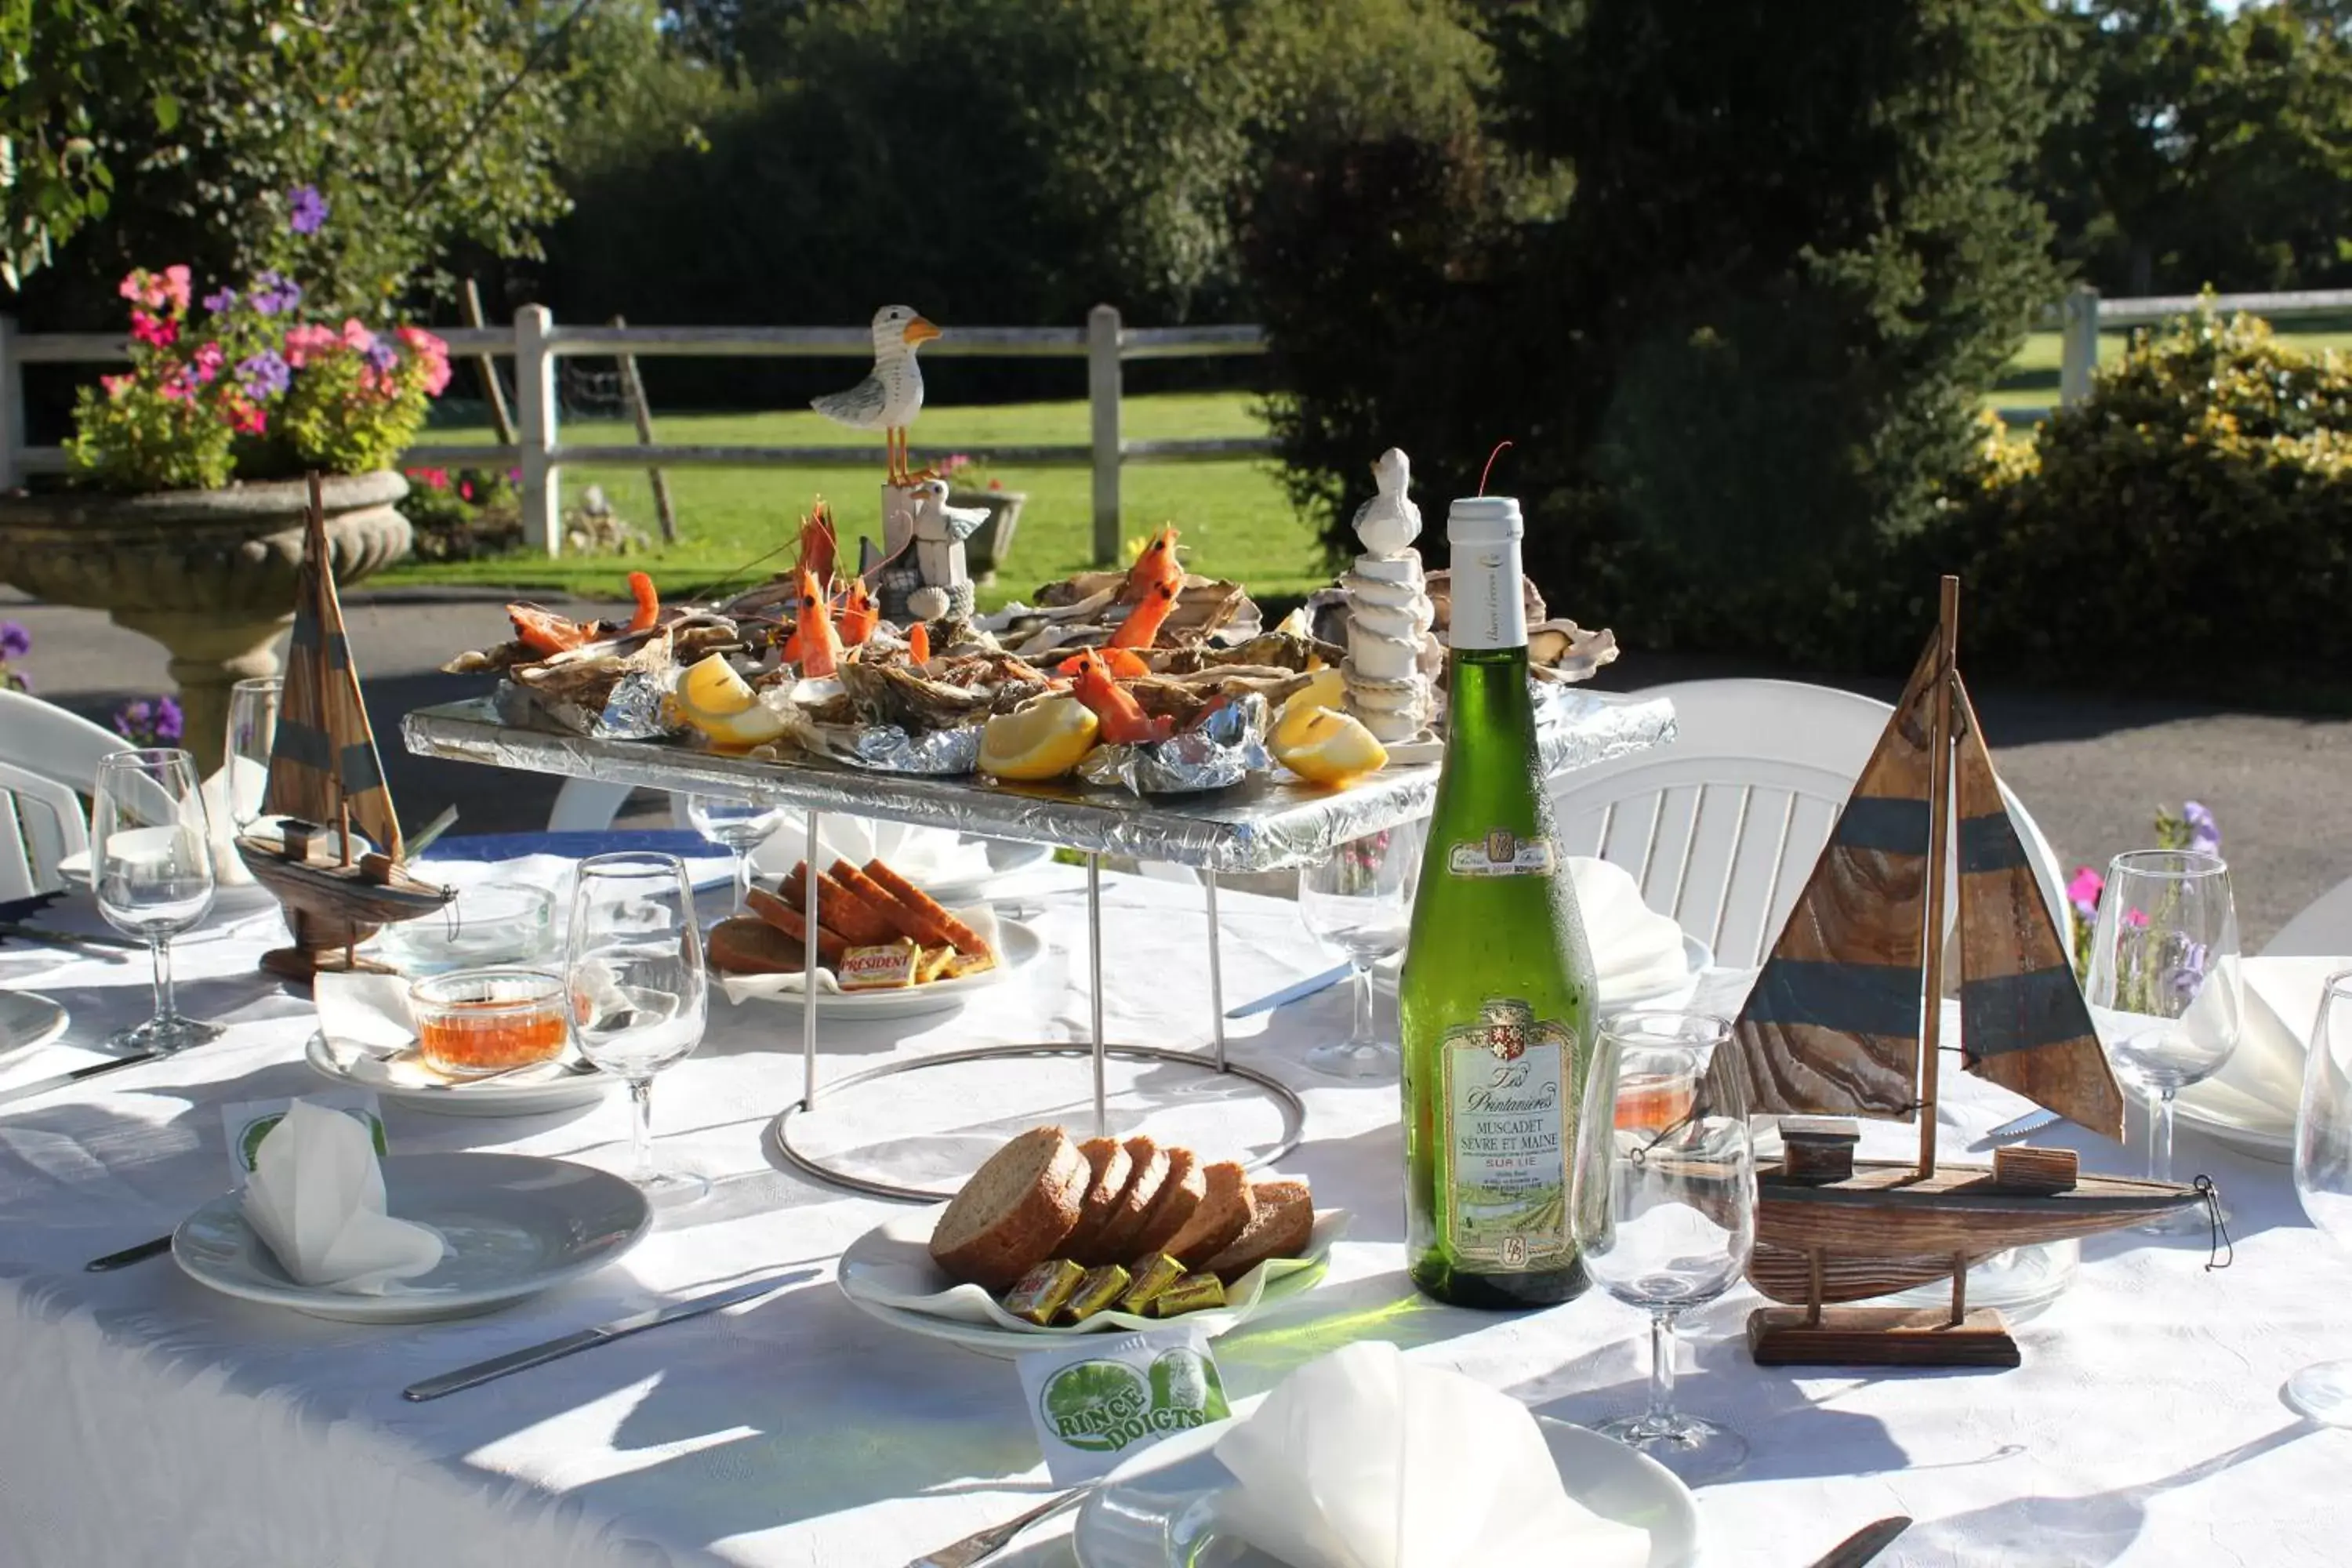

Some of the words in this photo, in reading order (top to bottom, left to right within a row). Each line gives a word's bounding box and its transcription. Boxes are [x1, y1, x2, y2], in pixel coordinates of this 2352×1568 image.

[1476, 1119, 1543, 1134] MUSCADET
[1501, 1138, 1516, 1150] ET
[1520, 1132, 1558, 1149] MAINE
[1056, 1385, 1145, 1439] RINCE
[1105, 1408, 1205, 1451] DOIGTS
